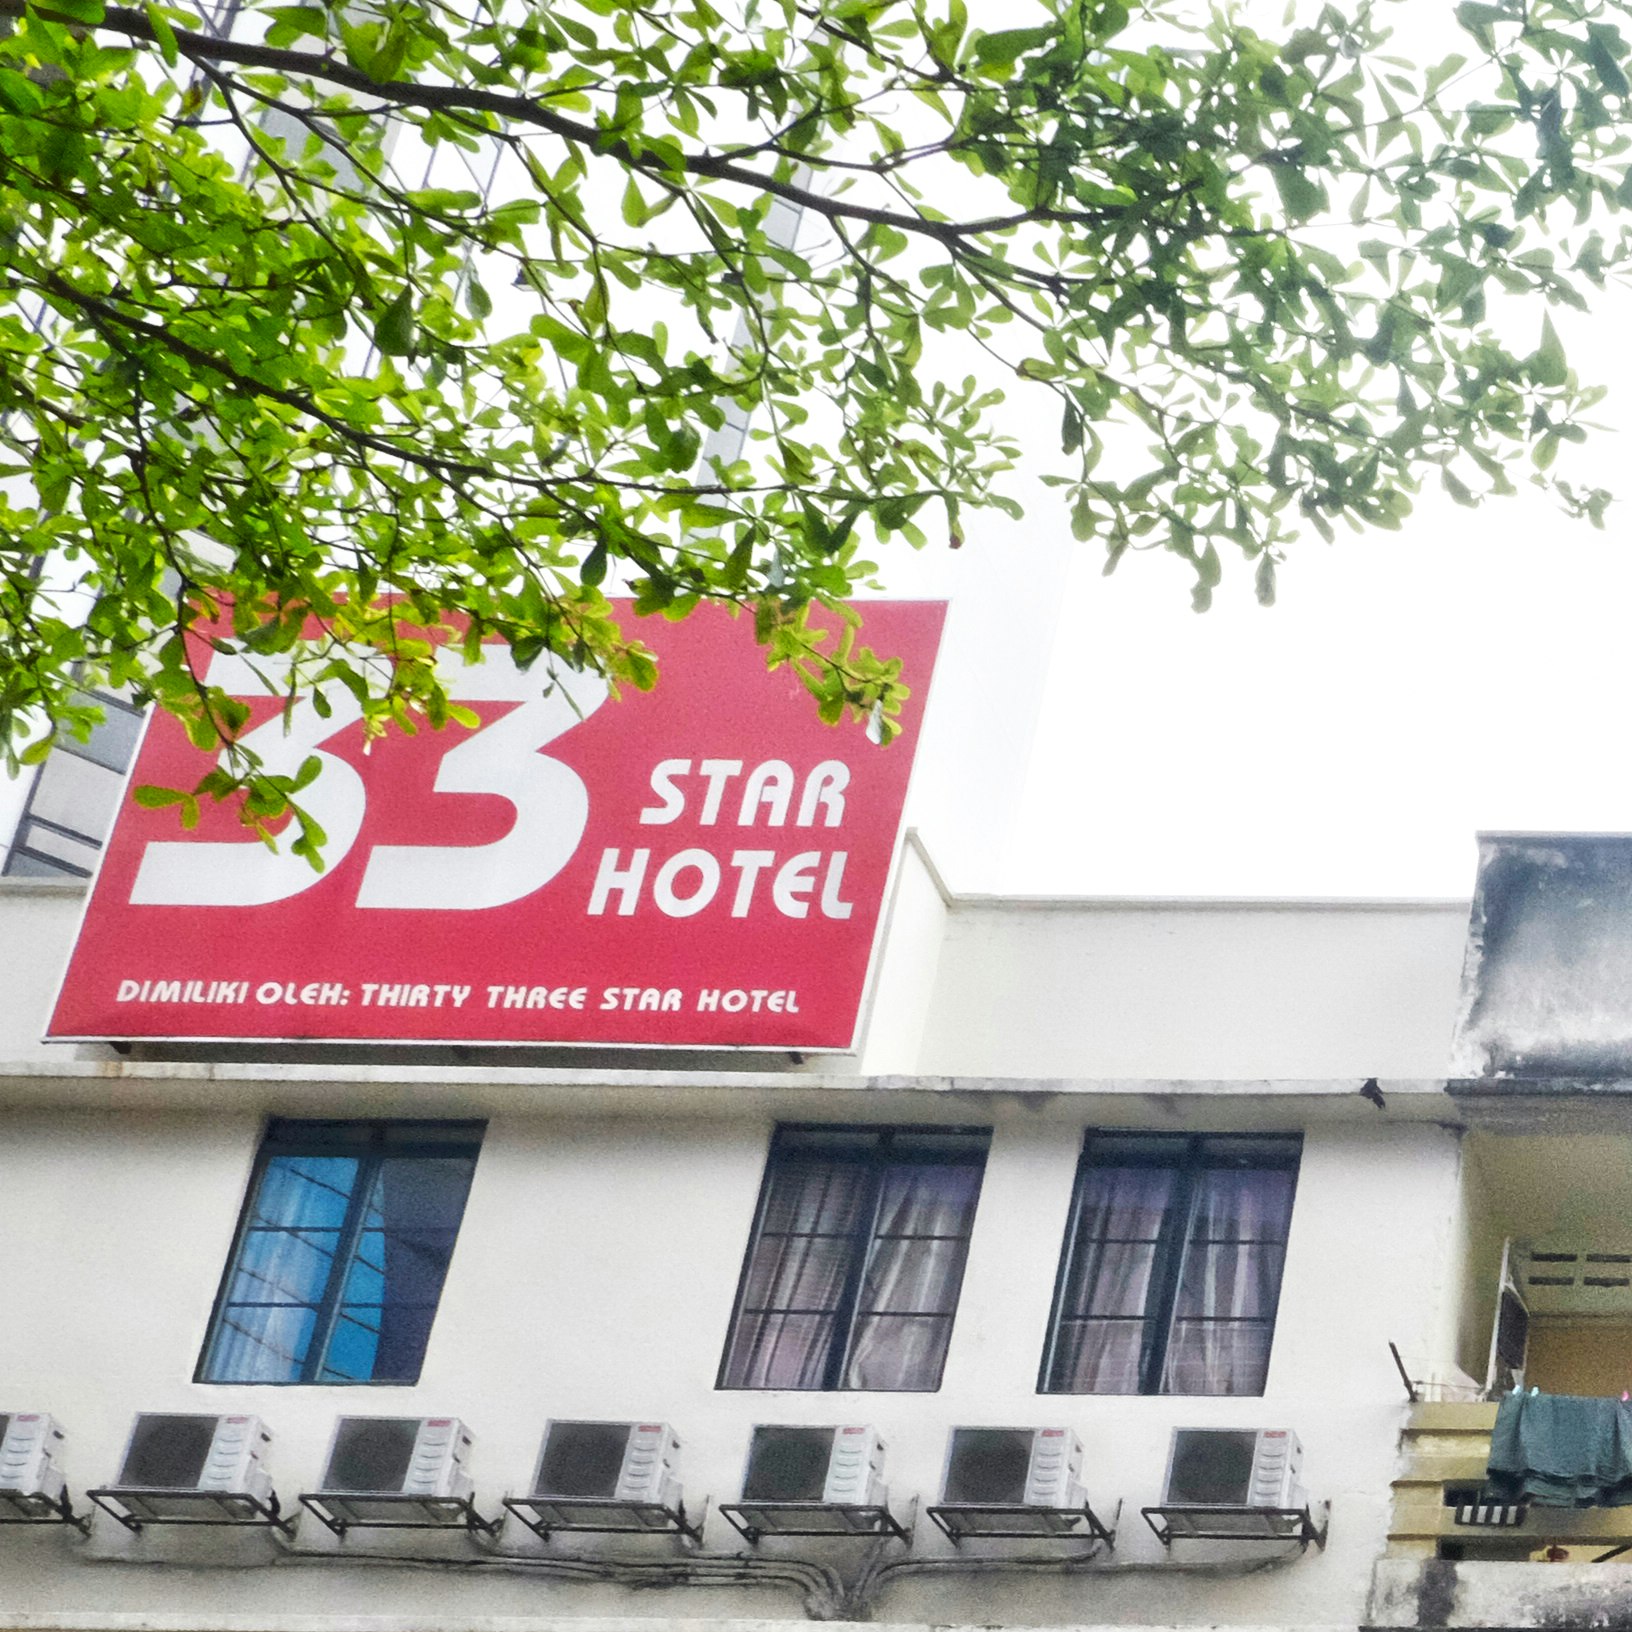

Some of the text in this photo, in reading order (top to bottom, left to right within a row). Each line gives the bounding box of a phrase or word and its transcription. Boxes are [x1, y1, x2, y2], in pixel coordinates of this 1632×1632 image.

[128, 640, 609, 911] 33
[639, 758, 852, 828] STAR
[586, 848, 854, 920] HOTEL
[116, 979, 800, 1014] DIMILIKI OLEH: THIRTY THREE STAR HOTEL
